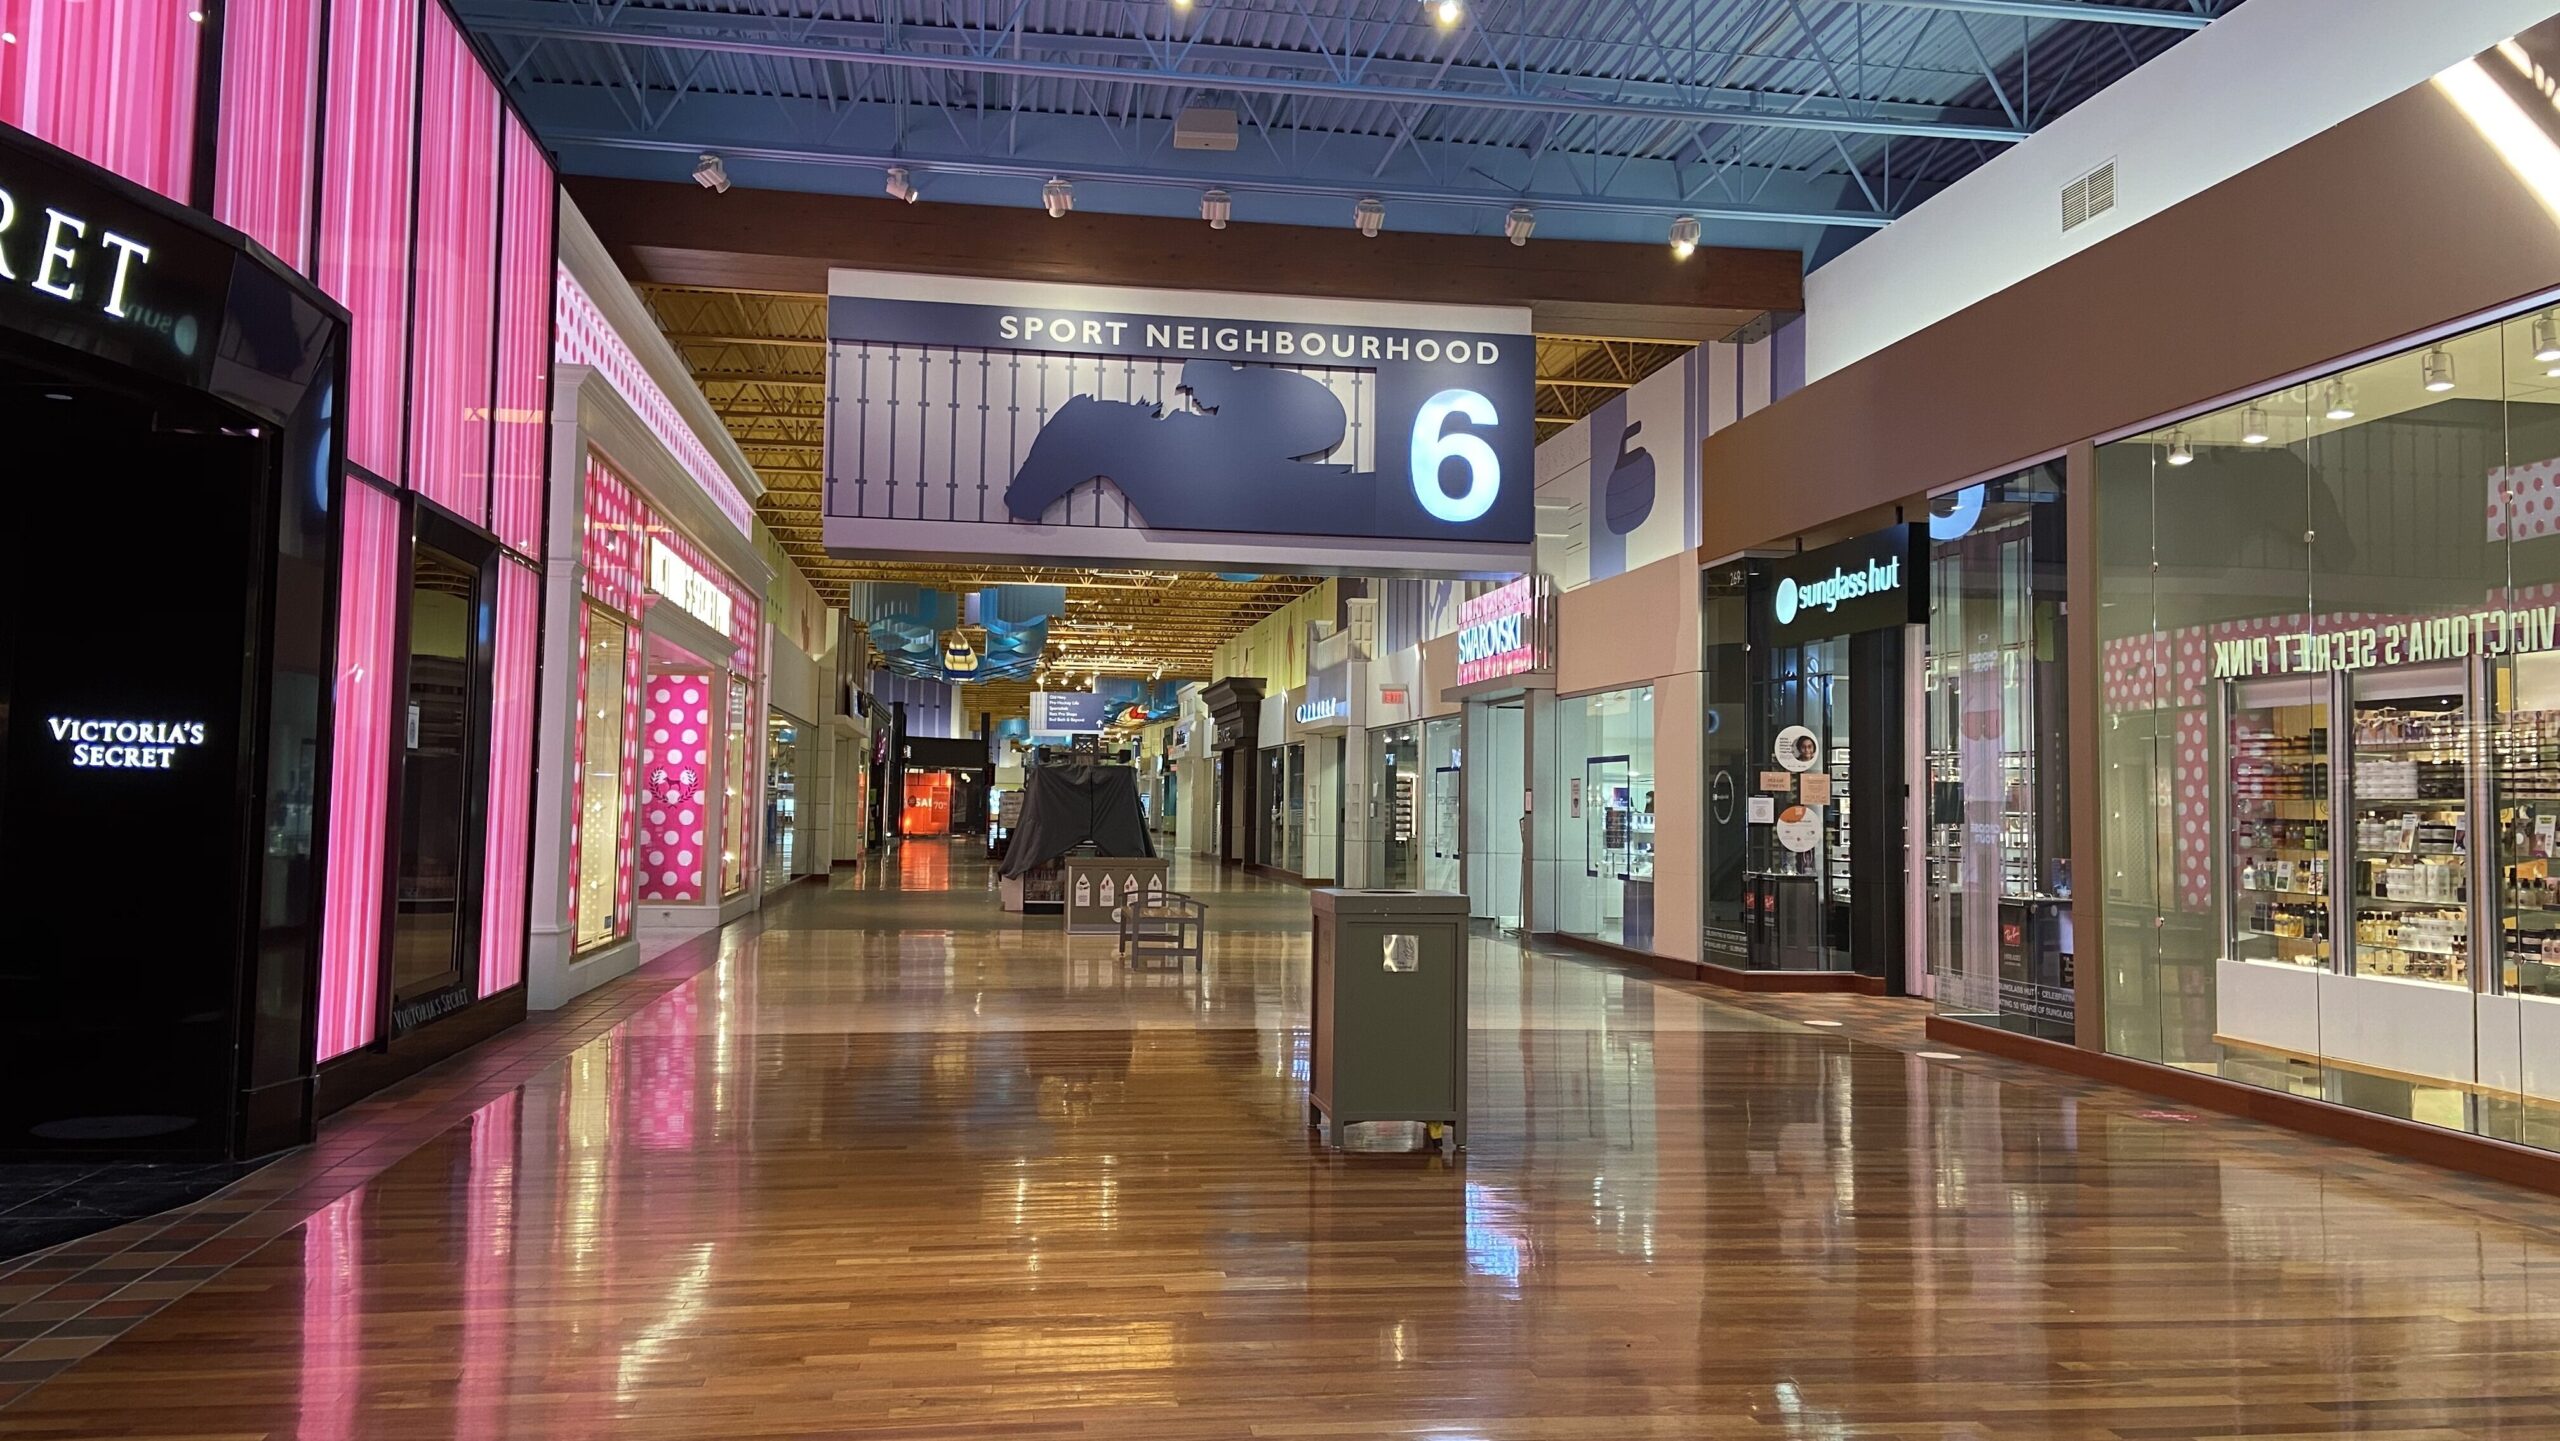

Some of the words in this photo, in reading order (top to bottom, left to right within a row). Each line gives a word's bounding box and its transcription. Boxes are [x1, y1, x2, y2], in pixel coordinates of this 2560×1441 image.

[998, 314, 1129, 347] SPORT
[1145, 322, 1501, 367] NEIGHBOURHOOD
[1410, 388, 1502, 525] 6
[1798, 566, 1868, 613] sunglass
[1867, 555, 1901, 594] hut
[1458, 612, 1522, 665] SWAROVSKI
[48, 717, 205, 745] VICTORIA'S
[72, 743, 176, 768] SECRET
